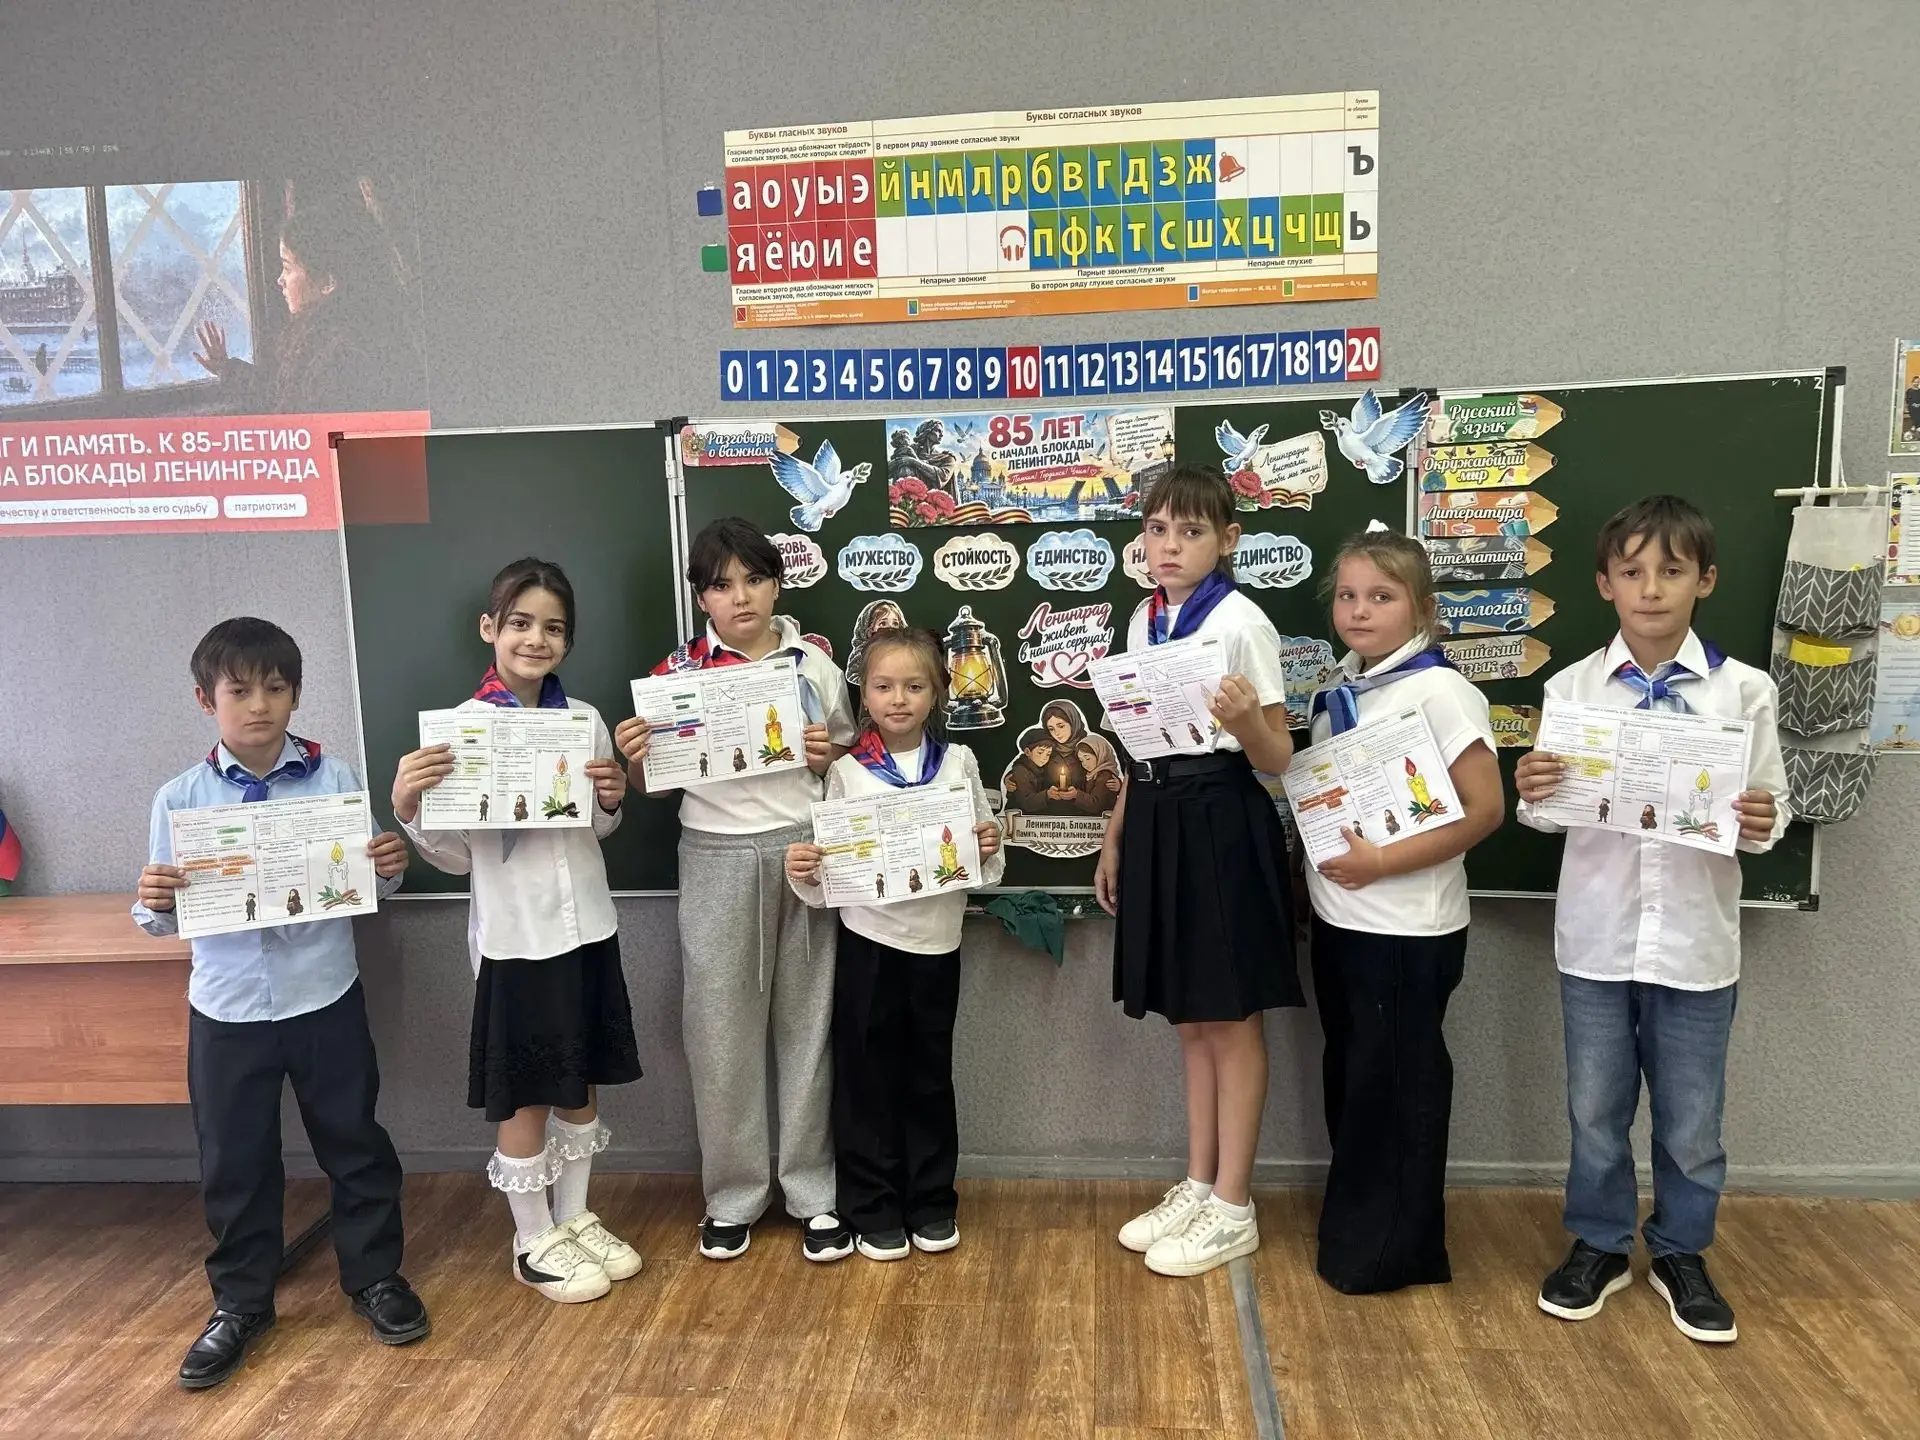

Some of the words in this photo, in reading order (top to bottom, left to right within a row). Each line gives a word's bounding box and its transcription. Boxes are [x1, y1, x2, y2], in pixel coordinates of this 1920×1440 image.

[1026, 111, 1056, 123] Буквы
[1058, 108, 1107, 120] согласных
[1110, 106, 1142, 118] звуков
[748, 130, 776, 142] Буквы
[778, 128, 814, 138] гласных
[817, 126, 848, 136] звуков
[875, 142, 882, 150] В
[883, 140, 910, 150] первом
[910, 138, 929, 149] ряду
[930, 137, 959, 147] звонкие
[960, 134, 998, 145] согласные
[999, 133, 1020, 144] звуки
[727, 148, 752, 156] Гласные
[754, 147, 780, 155] первого
[798, 144, 837, 152] обозначают
[839, 148, 867, 157] следуют
[1031, 152, 1052, 193] б
[817, 176, 843, 205] ы
[1248, 259, 1285, 268] Непарные
[1287, 257, 1313, 266] глухие
[920, 276, 957, 285] Непарные
[958, 275, 987, 283] звонкие
[1077, 269, 1106, 278] Парные
[1107, 265, 1164, 275] звонкие/глухие
[806, 284, 843, 292] обозначают
[845, 282, 874, 290] мягкость
[1031, 282, 1040, 290] Во
[1042, 281, 1069, 289] втором
[1070, 280, 1087, 289] ряду
[1089, 278, 1114, 287] глухие
[1116, 277, 1153, 286] согласные
[1155, 275, 1176, 284] звуки
[815, 290, 843, 298] которых
[844, 289, 872, 297] следуют
[727, 359, 743, 393] 0
[755, 359, 768, 393] 1
[783, 359, 799, 393] 2
[812, 358, 827, 393] 3
[840, 358, 858, 393] 4
[869, 358, 885, 393] 5
[897, 357, 914, 392] 6
[926, 357, 942, 392] 7
[955, 356, 972, 392] 8
[984, 356, 1001, 391] 9
[1011, 355, 1037, 390] 10
[1044, 354, 1069, 389] 11
[1077, 352, 1105, 388] 12
[1111, 350, 1138, 386] 13
[1145, 348, 1174, 384] 14
[1179, 346, 1207, 382] 15
[1212, 344, 1242, 380] 16
[1246, 342, 1275, 378] 17
[1280, 340, 1310, 377] 18
[1314, 338, 1344, 374] 19
[1347, 336, 1379, 373] 20
[1450, 402, 1517, 424] Русский
[988, 416, 1033, 448] 85
[1041, 415, 1085, 441] ЛЕТ
[1462, 420, 1507, 438] язык
[0, 437, 14, 458] Г
[21, 436, 38, 457] И
[45, 433, 152, 456] ПАМЯТЬ.
[159, 432, 176, 453] К
[181, 429, 311, 453] 85-ЛЕТИЮ
[707, 431, 775, 447] Разговоры
[709, 449, 715, 458] о
[719, 445, 774, 457] важном
[991, 451, 997, 460] С
[1000, 446, 1038, 459] НАЧАЛА
[1042, 439, 1094, 454] БЛОКАДЫ
[1008, 452, 1080, 470] ЛЕНИНГРАДА
[1423, 452, 1526, 471] Окружающий
[0, 466, 19, 487] А
[24, 462, 147, 488] БЛОКАДЫ
[153, 458, 320, 483] ЛЕНИНГРАДА
[1457, 469, 1488, 484] мир
[0, 508, 39, 518] ечеству
[42, 508, 48, 516] и
[51, 505, 136, 516] ответственность
[138, 506, 150, 514] за
[153, 505, 170, 515] его
[172, 502, 208, 514] судьбу
[235, 502, 296, 515] патриотизм
[1426, 504, 1524, 524] Литература
[777, 541, 807, 555] БОВЬ
[784, 553, 814, 569] ДИНЕ
[845, 550, 915, 569] МУЖЕСТВО
[941, 547, 1012, 569] СТОЙКОСТЬ
[1034, 547, 1107, 567] ЕДИНСТВО
[1439, 602, 1523, 618] ехнология
[1020, 603, 1110, 637] Ленинград
[1042, 622, 1088, 644] живет
[1020, 642, 1028, 661] в
[1030, 642, 1065, 659] наших
[1066, 628, 1113, 652] сердцах!
[1447, 641, 1522, 661] глийский
[1280, 655, 1328, 674] од-герой!
[1025, 819, 1068, 830] Ленинград.
[1069, 820, 1104, 830] Блокада.
[1016, 830, 1039, 838] Память,
[1040, 831, 1062, 839] которая
[1087, 832, 1104, 840] време
